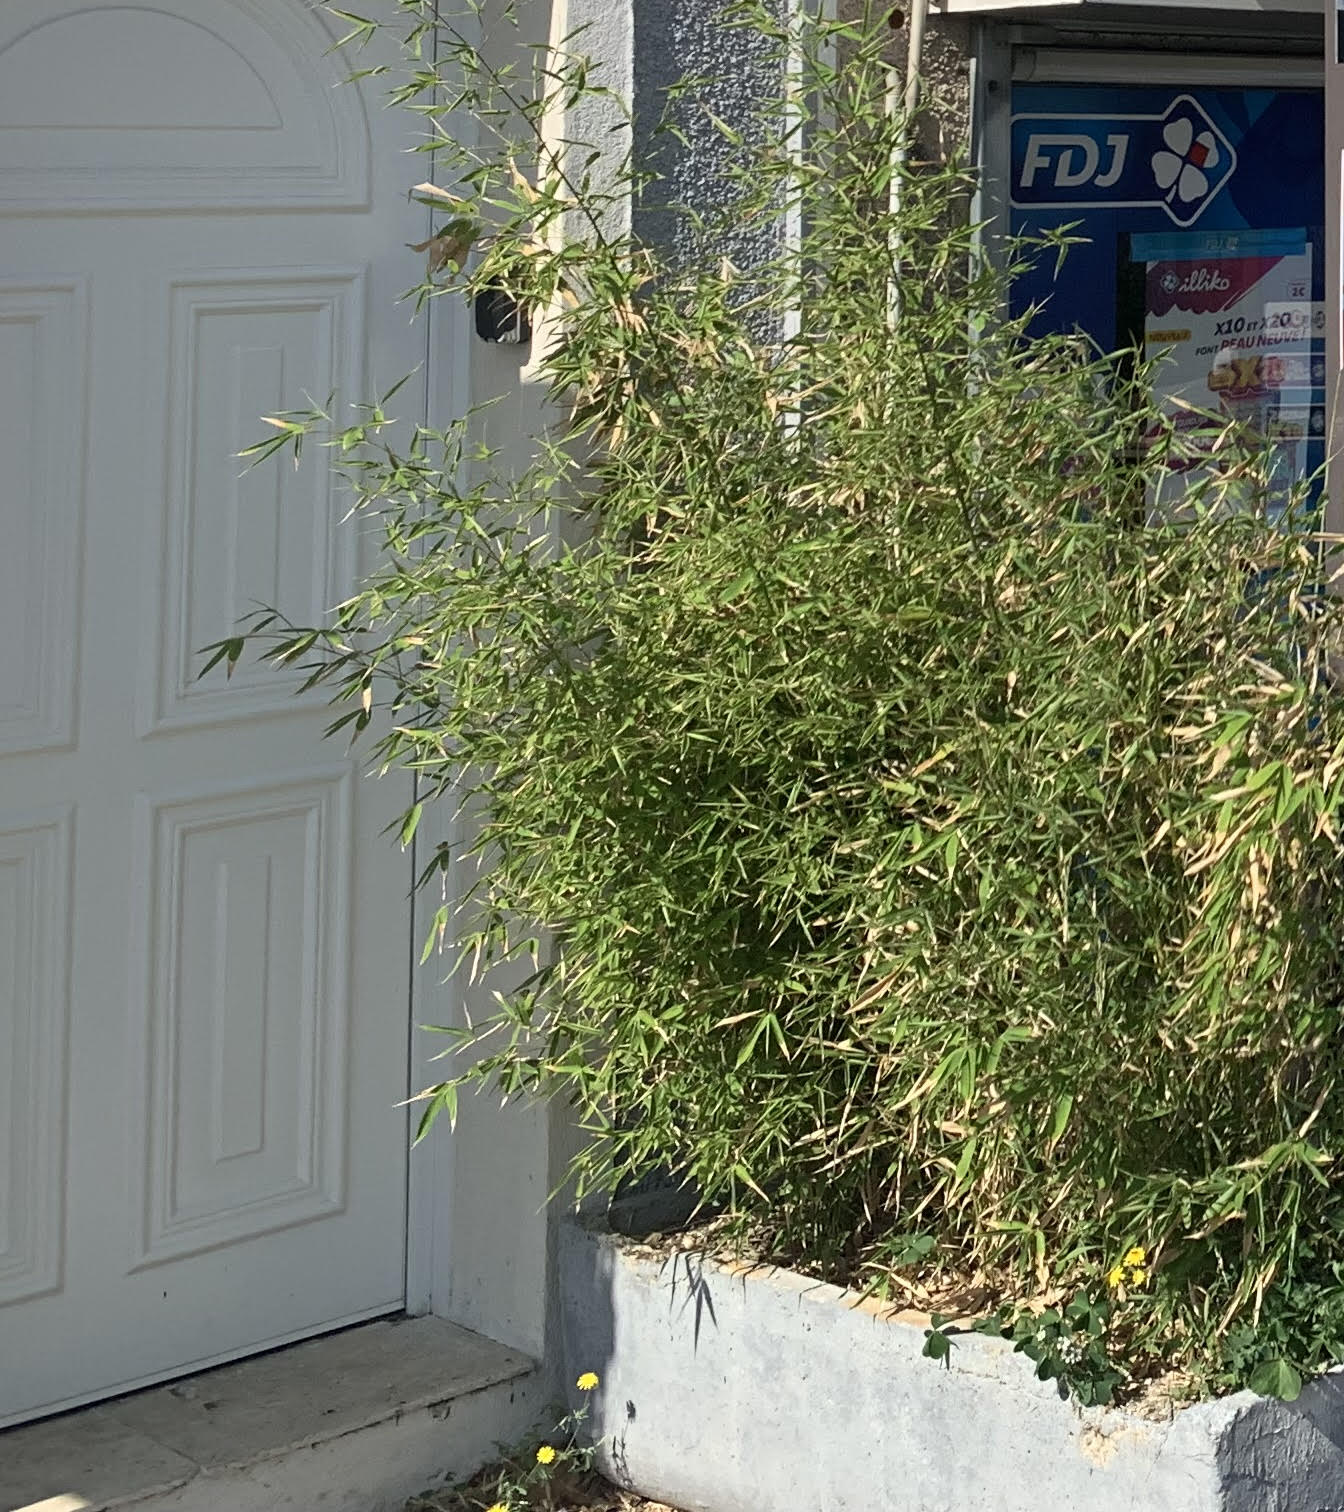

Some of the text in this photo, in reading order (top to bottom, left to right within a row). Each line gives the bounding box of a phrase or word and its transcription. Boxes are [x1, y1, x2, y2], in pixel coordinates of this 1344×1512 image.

[1020, 134, 1135, 188] FDJ
[1178, 268, 1231, 292] illiko
[1214, 318, 1246, 337] X10
[1196, 345, 1219, 356] FONT
[1221, 337, 1255, 352] PEAU
